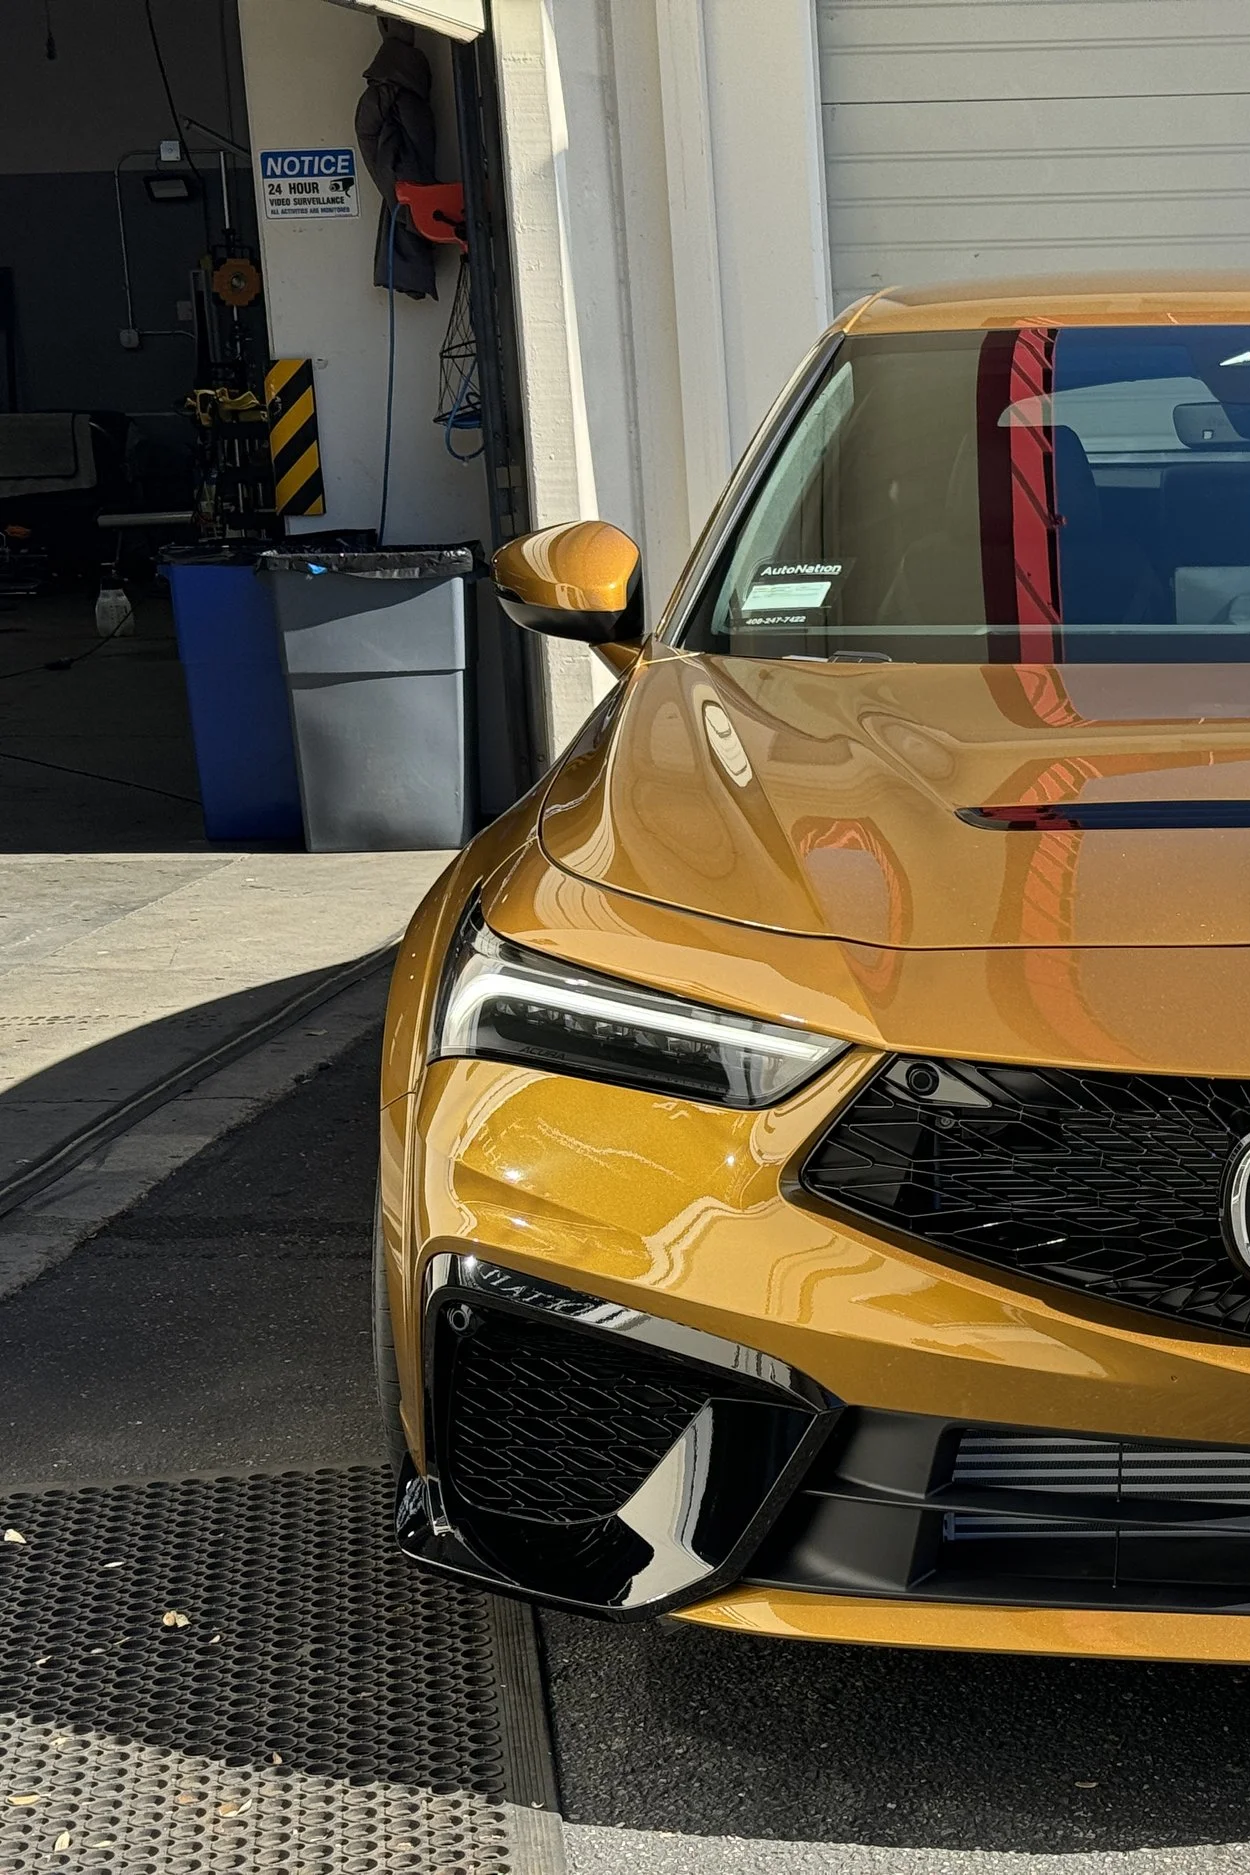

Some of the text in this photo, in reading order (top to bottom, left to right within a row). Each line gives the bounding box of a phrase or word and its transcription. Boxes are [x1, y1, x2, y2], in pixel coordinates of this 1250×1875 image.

[266, 154, 351, 176] NOTICE
[268, 181, 320, 195] 24 HOUR
[269, 196, 345, 207] VIDEO SURVEILLANCE
[760, 563, 843, 577] AutoNation
[520, 1045, 567, 1060] ACURA
